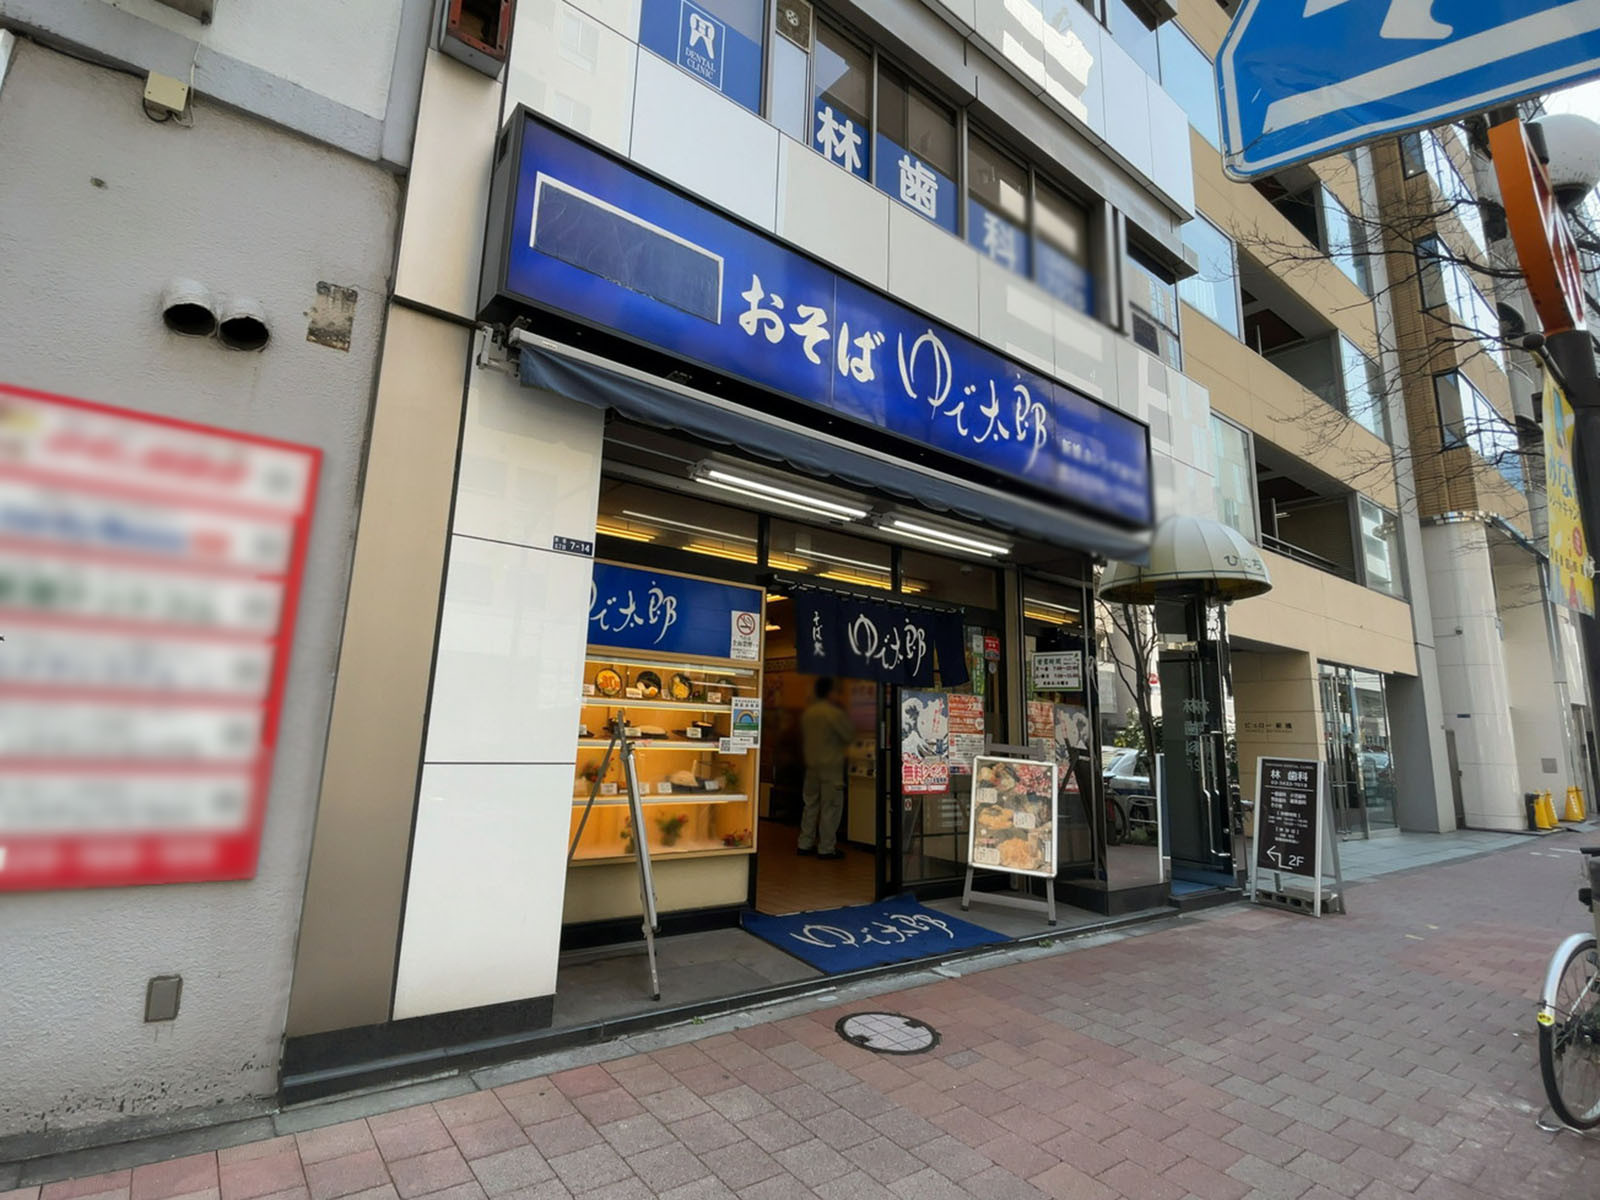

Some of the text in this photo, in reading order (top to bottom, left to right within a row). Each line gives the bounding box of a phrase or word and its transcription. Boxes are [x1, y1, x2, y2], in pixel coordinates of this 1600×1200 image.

[685, 47, 716, 73] DENTAL
[686, 57, 714, 80] CLINIC
[739, 274, 886, 383] おそば
[898, 328, 1047, 473] ゆで太郎
[570, 541, 591, 553] 7-14
[589, 579, 677, 645] で太郎
[848, 613, 926, 677] ゆで太郎
[1287, 770, 1308, 782] 歯科
[1288, 854, 1304, 867] 2F
[790, 913, 954, 948] ゆで太郎
